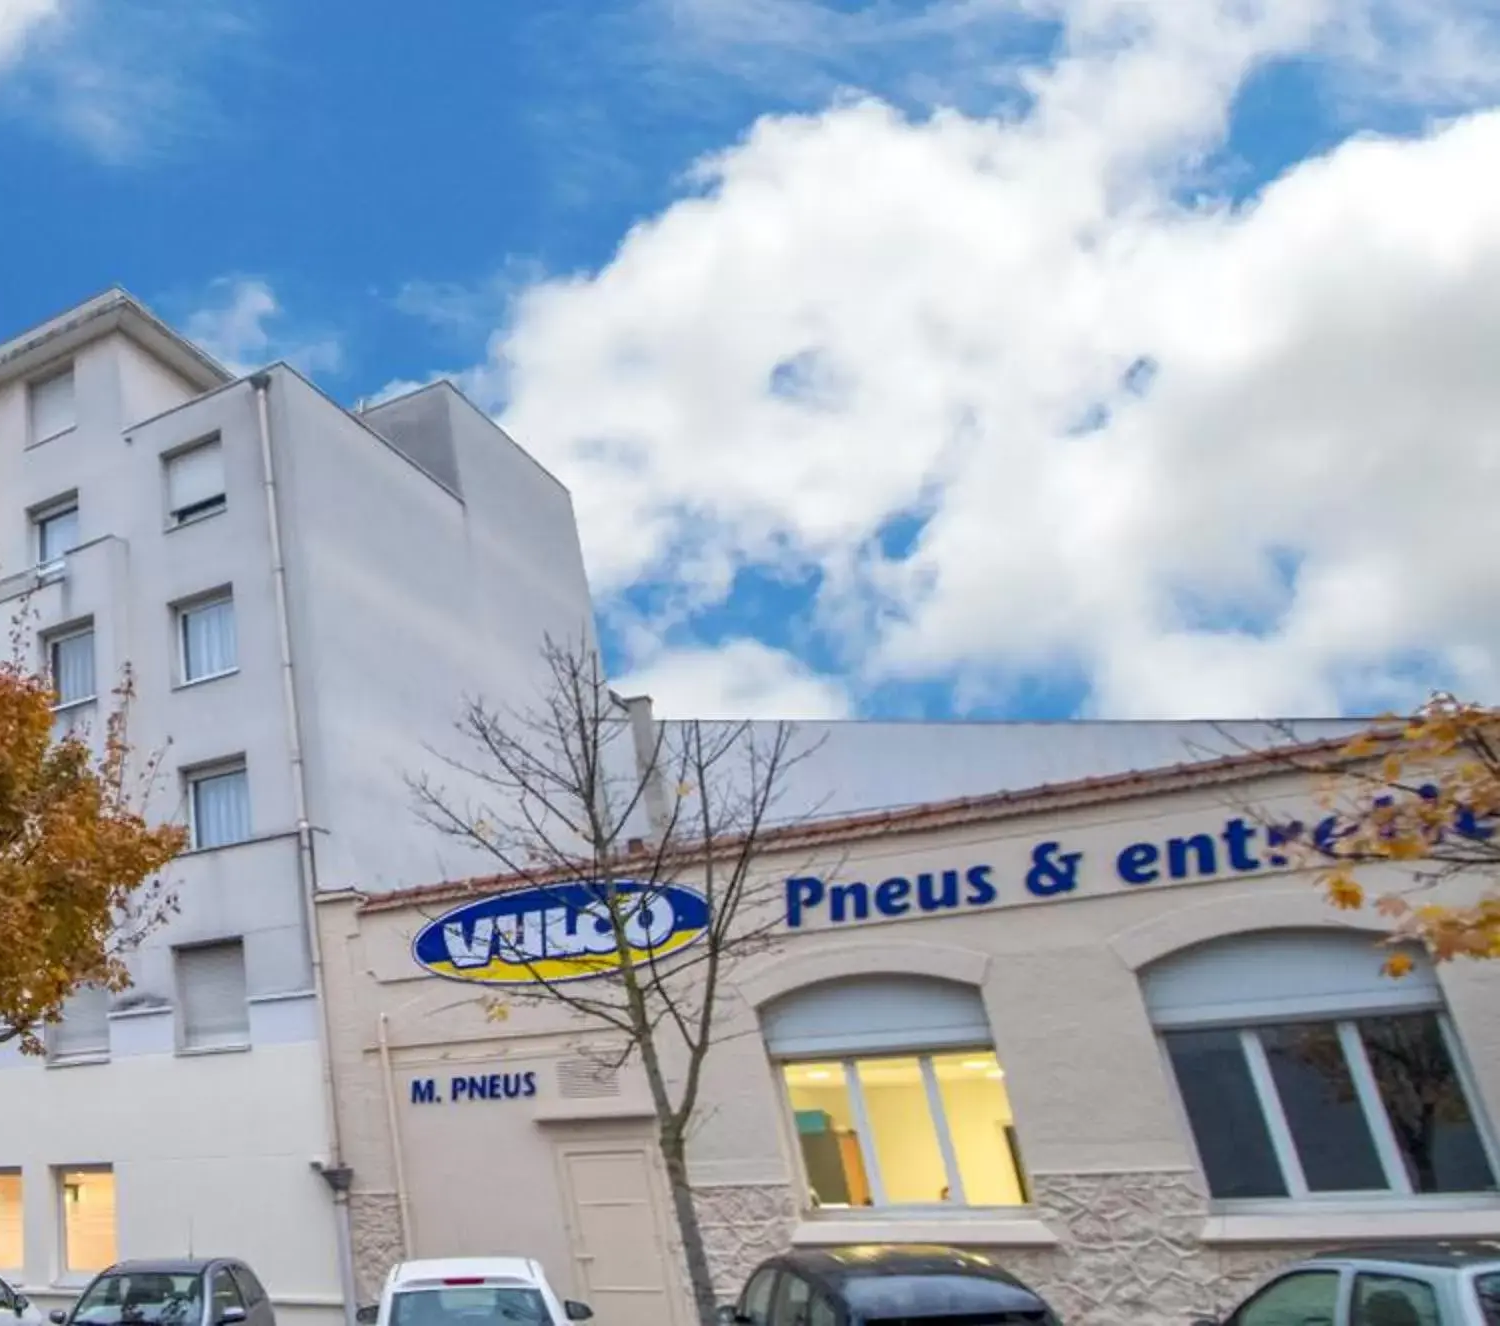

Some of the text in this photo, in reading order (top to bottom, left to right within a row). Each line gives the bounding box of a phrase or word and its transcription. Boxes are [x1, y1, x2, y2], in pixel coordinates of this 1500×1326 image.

[786, 864, 997, 928] Pneus
[1025, 841, 1083, 896] &
[442, 892, 675, 968] VULCO
[411, 1071, 537, 1104] M. PNEUS
